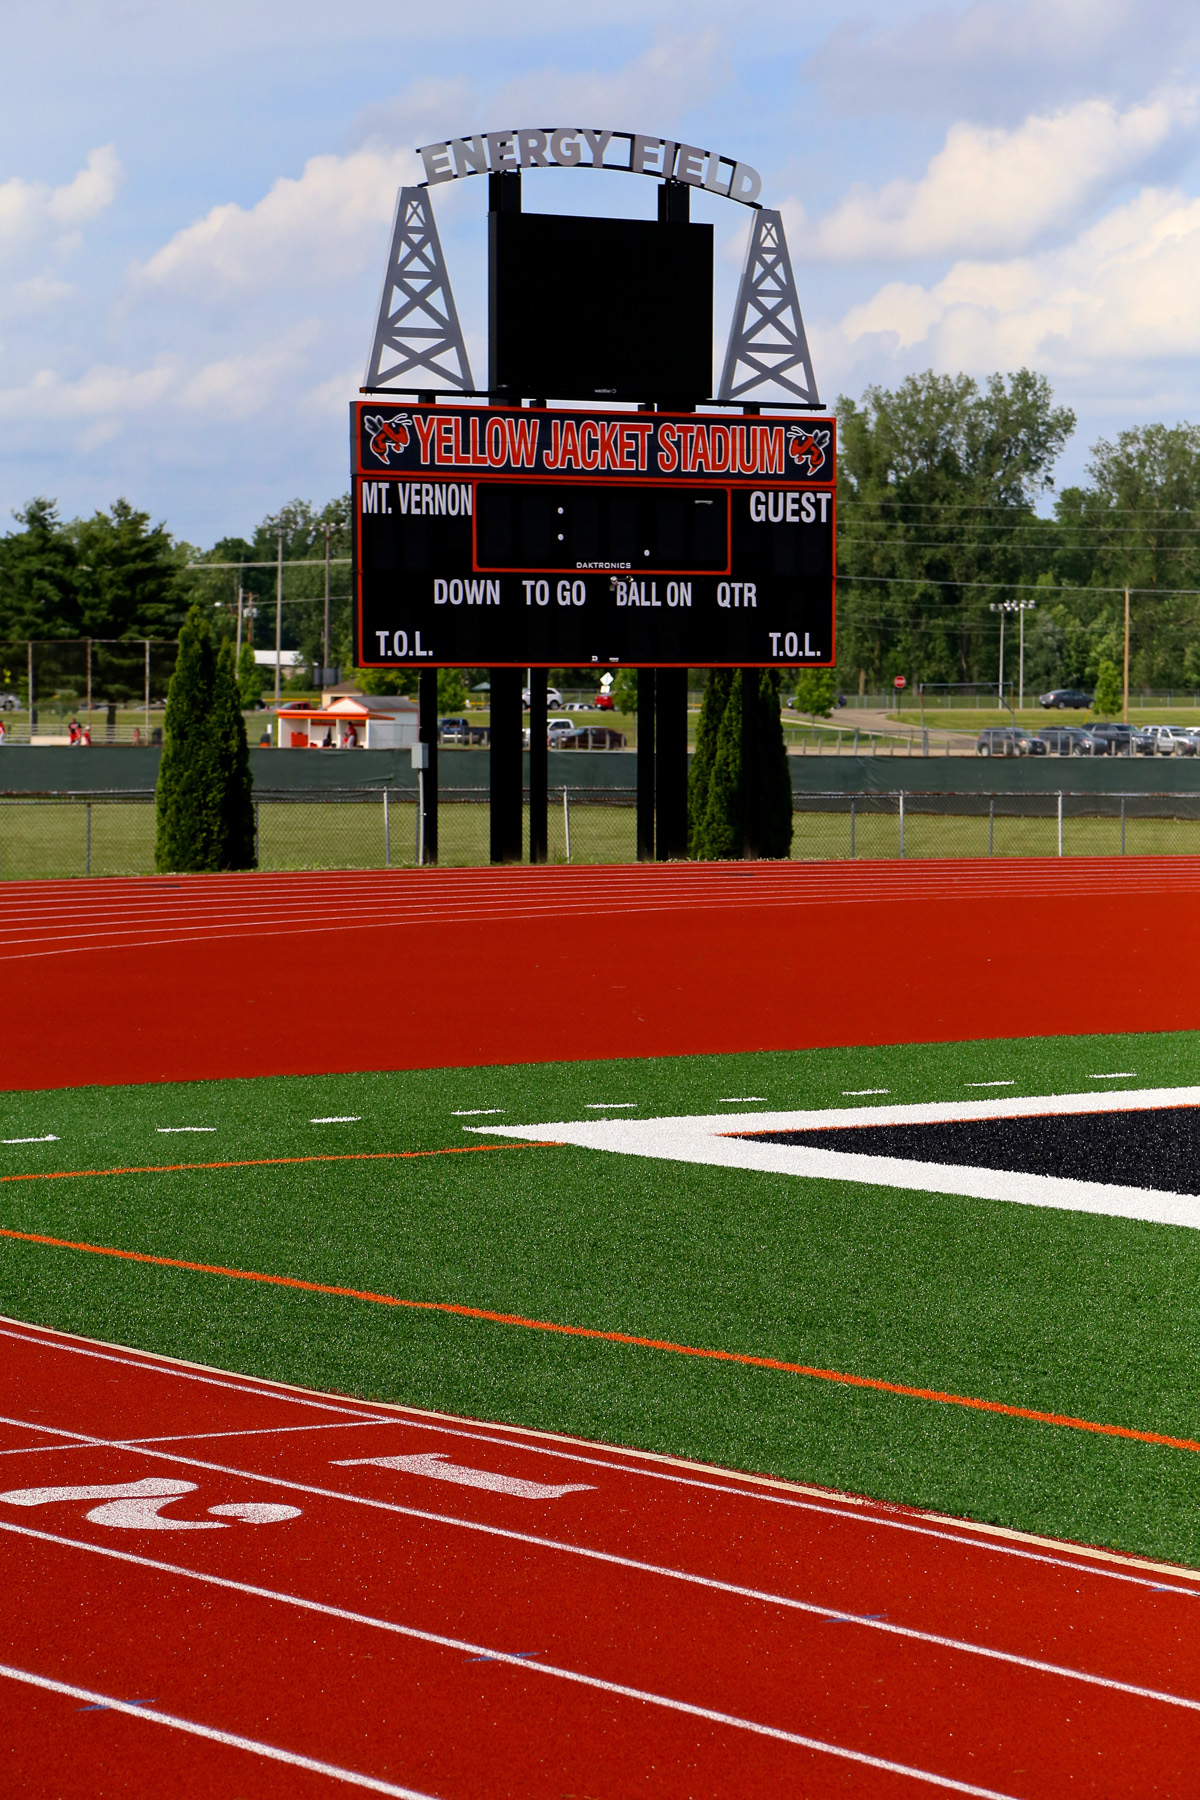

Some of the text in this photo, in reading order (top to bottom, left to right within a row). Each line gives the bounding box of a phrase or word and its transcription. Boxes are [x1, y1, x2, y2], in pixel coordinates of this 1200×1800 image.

[420, 128, 762, 203] ENERGY FIELD
[413, 414, 785, 475] YELLOW JACKET STADIUM
[362, 482, 472, 516] MT. VERNON
[750, 491, 832, 523] GUEST
[434, 579, 500, 605] DOWN
[522, 580, 586, 606] TO GO
[616, 581, 692, 607] BALL ON
[717, 582, 757, 608] QTR
[375, 630, 433, 656] T.O.L.
[769, 632, 821, 657] T.O.L.
[328, 1453, 599, 1499] 1
[0, 1477, 303, 1530] 2
